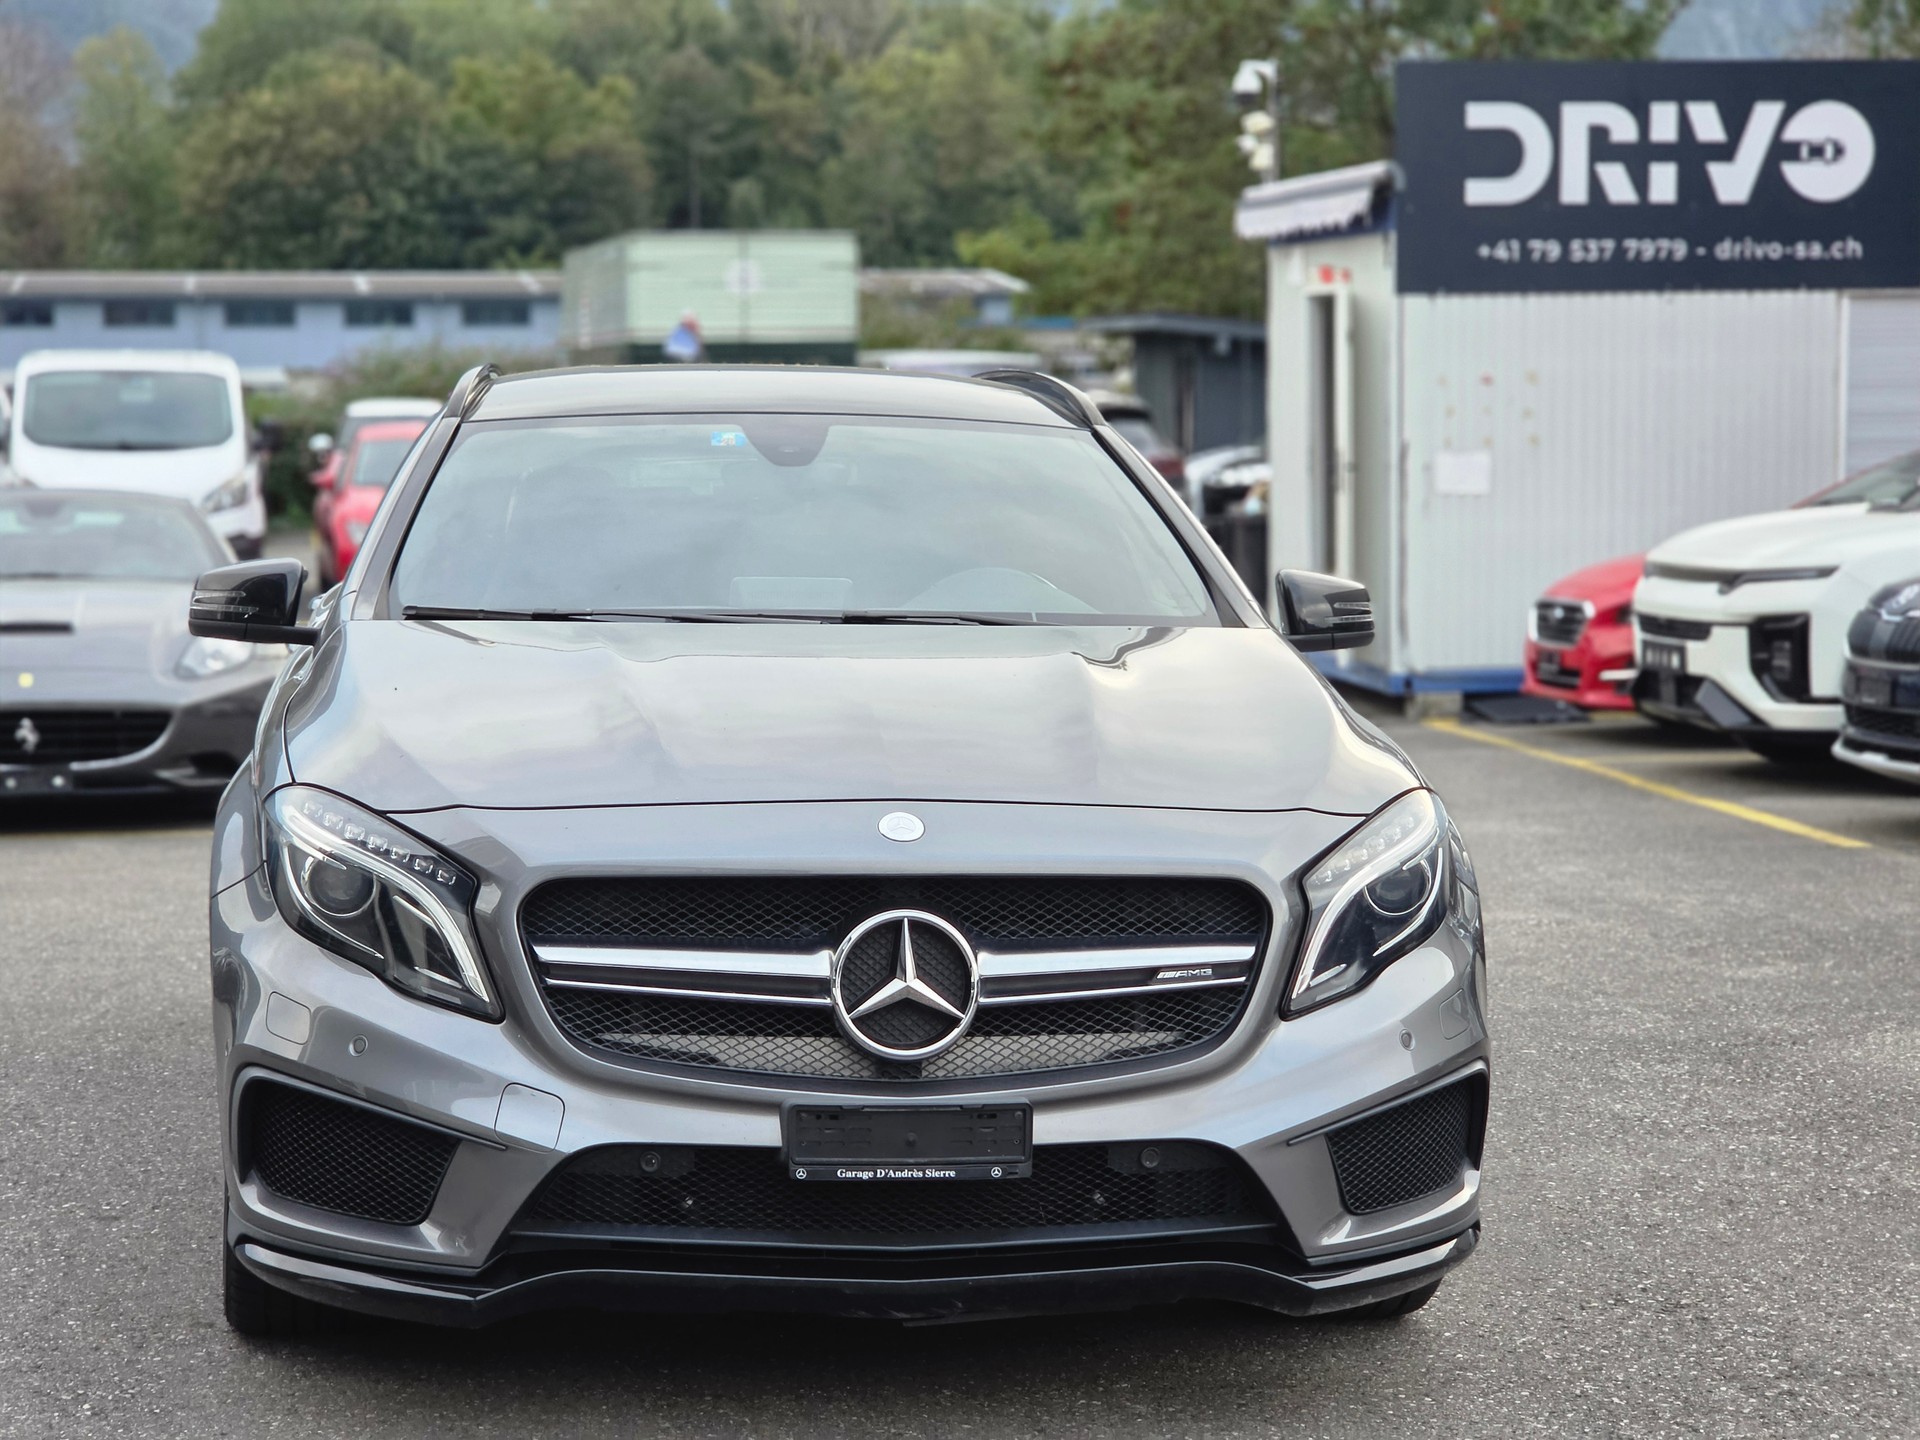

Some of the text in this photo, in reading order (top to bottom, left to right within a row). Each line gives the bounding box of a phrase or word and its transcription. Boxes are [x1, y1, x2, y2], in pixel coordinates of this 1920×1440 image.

[1464, 99, 1875, 206] DRIVO
[1478, 238, 1521, 262] +41
[1526, 238, 1563, 262] 79
[1569, 238, 1616, 262] 537
[1621, 238, 1688, 262] 7979
[1713, 236, 1864, 261] drivo-sa.ch
[1174, 968, 1213, 978] AMG
[837, 1168, 874, 1180] Garage
[925, 1168, 956, 1178] Sierre
